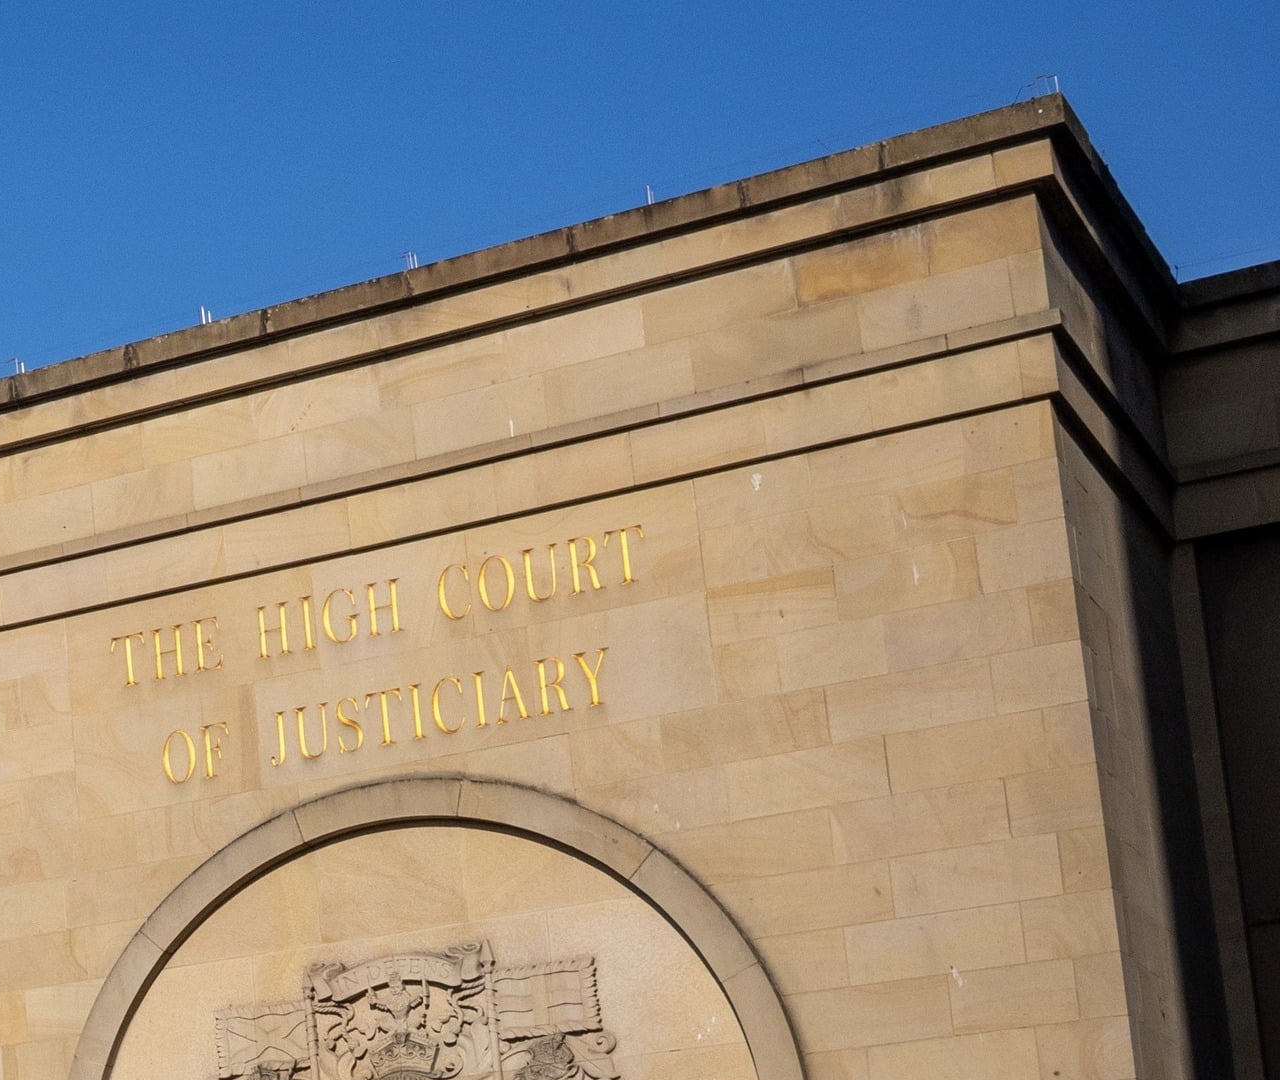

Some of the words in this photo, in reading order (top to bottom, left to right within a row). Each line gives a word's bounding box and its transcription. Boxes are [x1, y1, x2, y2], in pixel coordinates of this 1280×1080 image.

[111, 616, 223, 687] THE
[256, 577, 404, 659] HIGH
[438, 524, 644, 620] COURT
[162, 722, 229, 784] OF
[270, 647, 610, 766] JUSTICIARY
